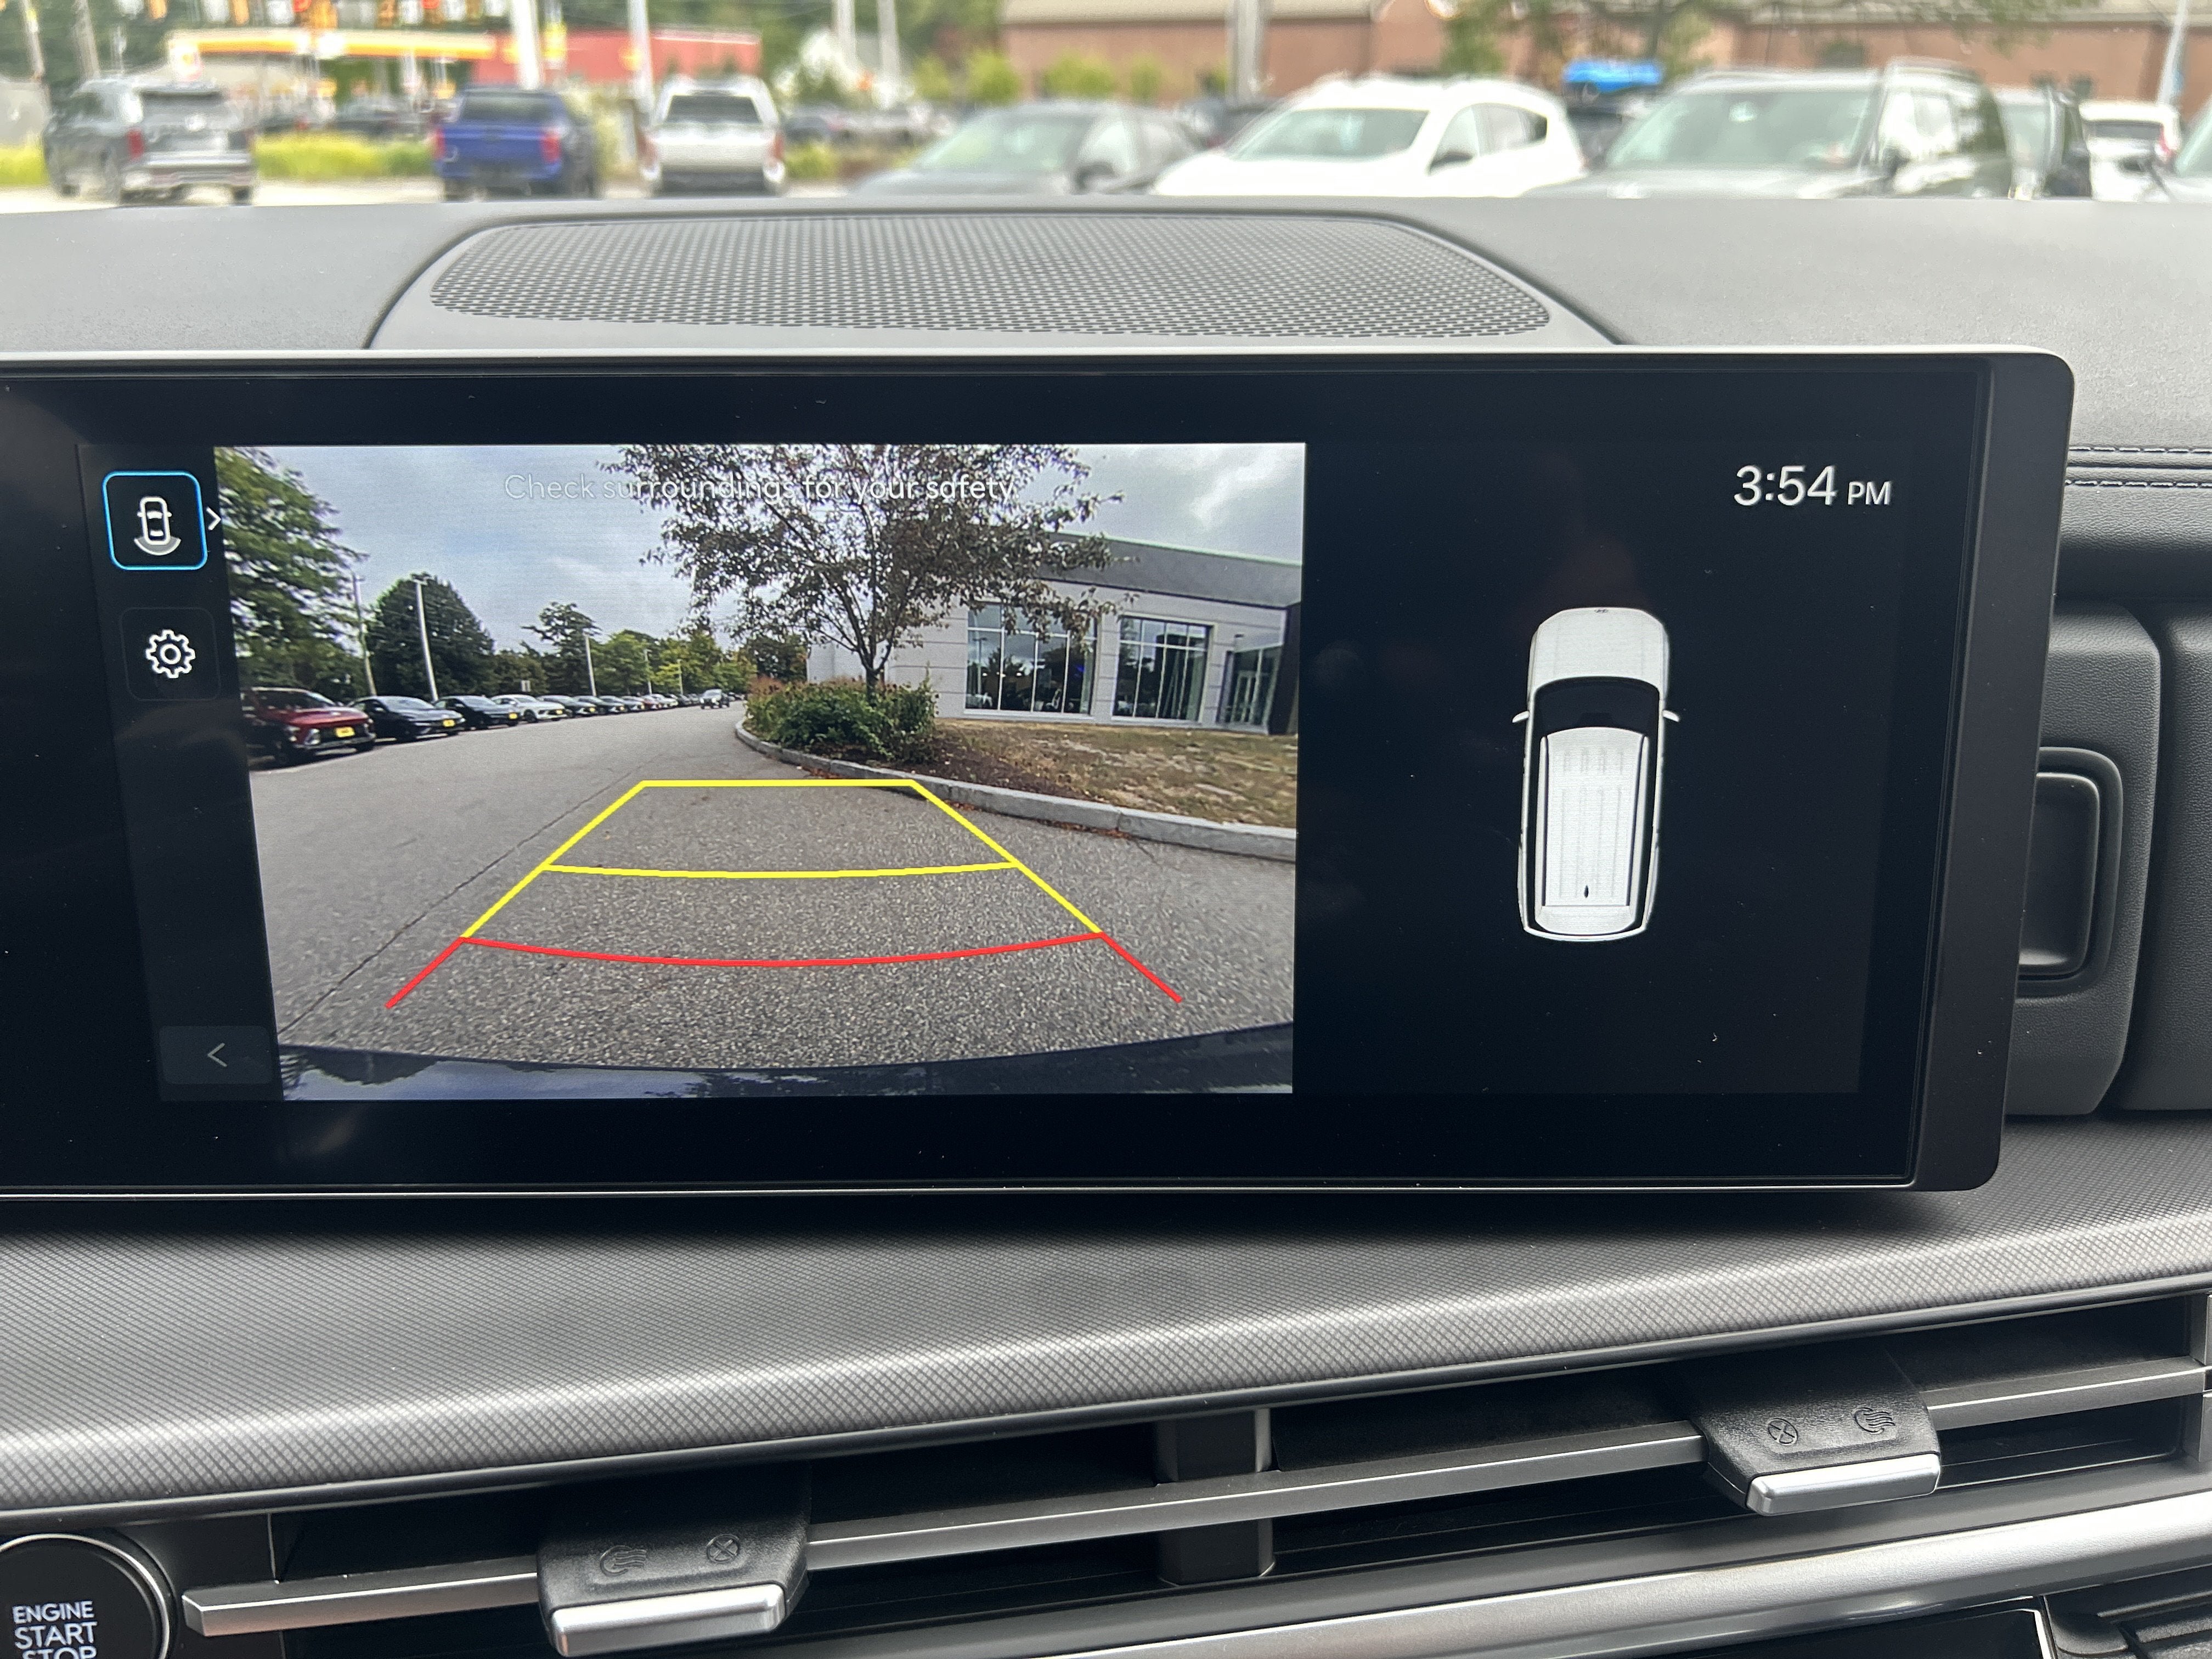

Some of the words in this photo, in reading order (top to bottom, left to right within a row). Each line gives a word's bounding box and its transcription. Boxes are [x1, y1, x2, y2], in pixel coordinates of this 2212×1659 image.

[505, 473, 596, 499] Check
[603, 472, 795, 505] surroundings
[802, 474, 844, 499] for
[853, 480, 918, 505] your
[1734, 465, 1837, 506] 3:54
[1847, 480, 1893, 505] PM
[13, 1600, 95, 1624] ENGINE
[14, 1621, 98, 1649] START
